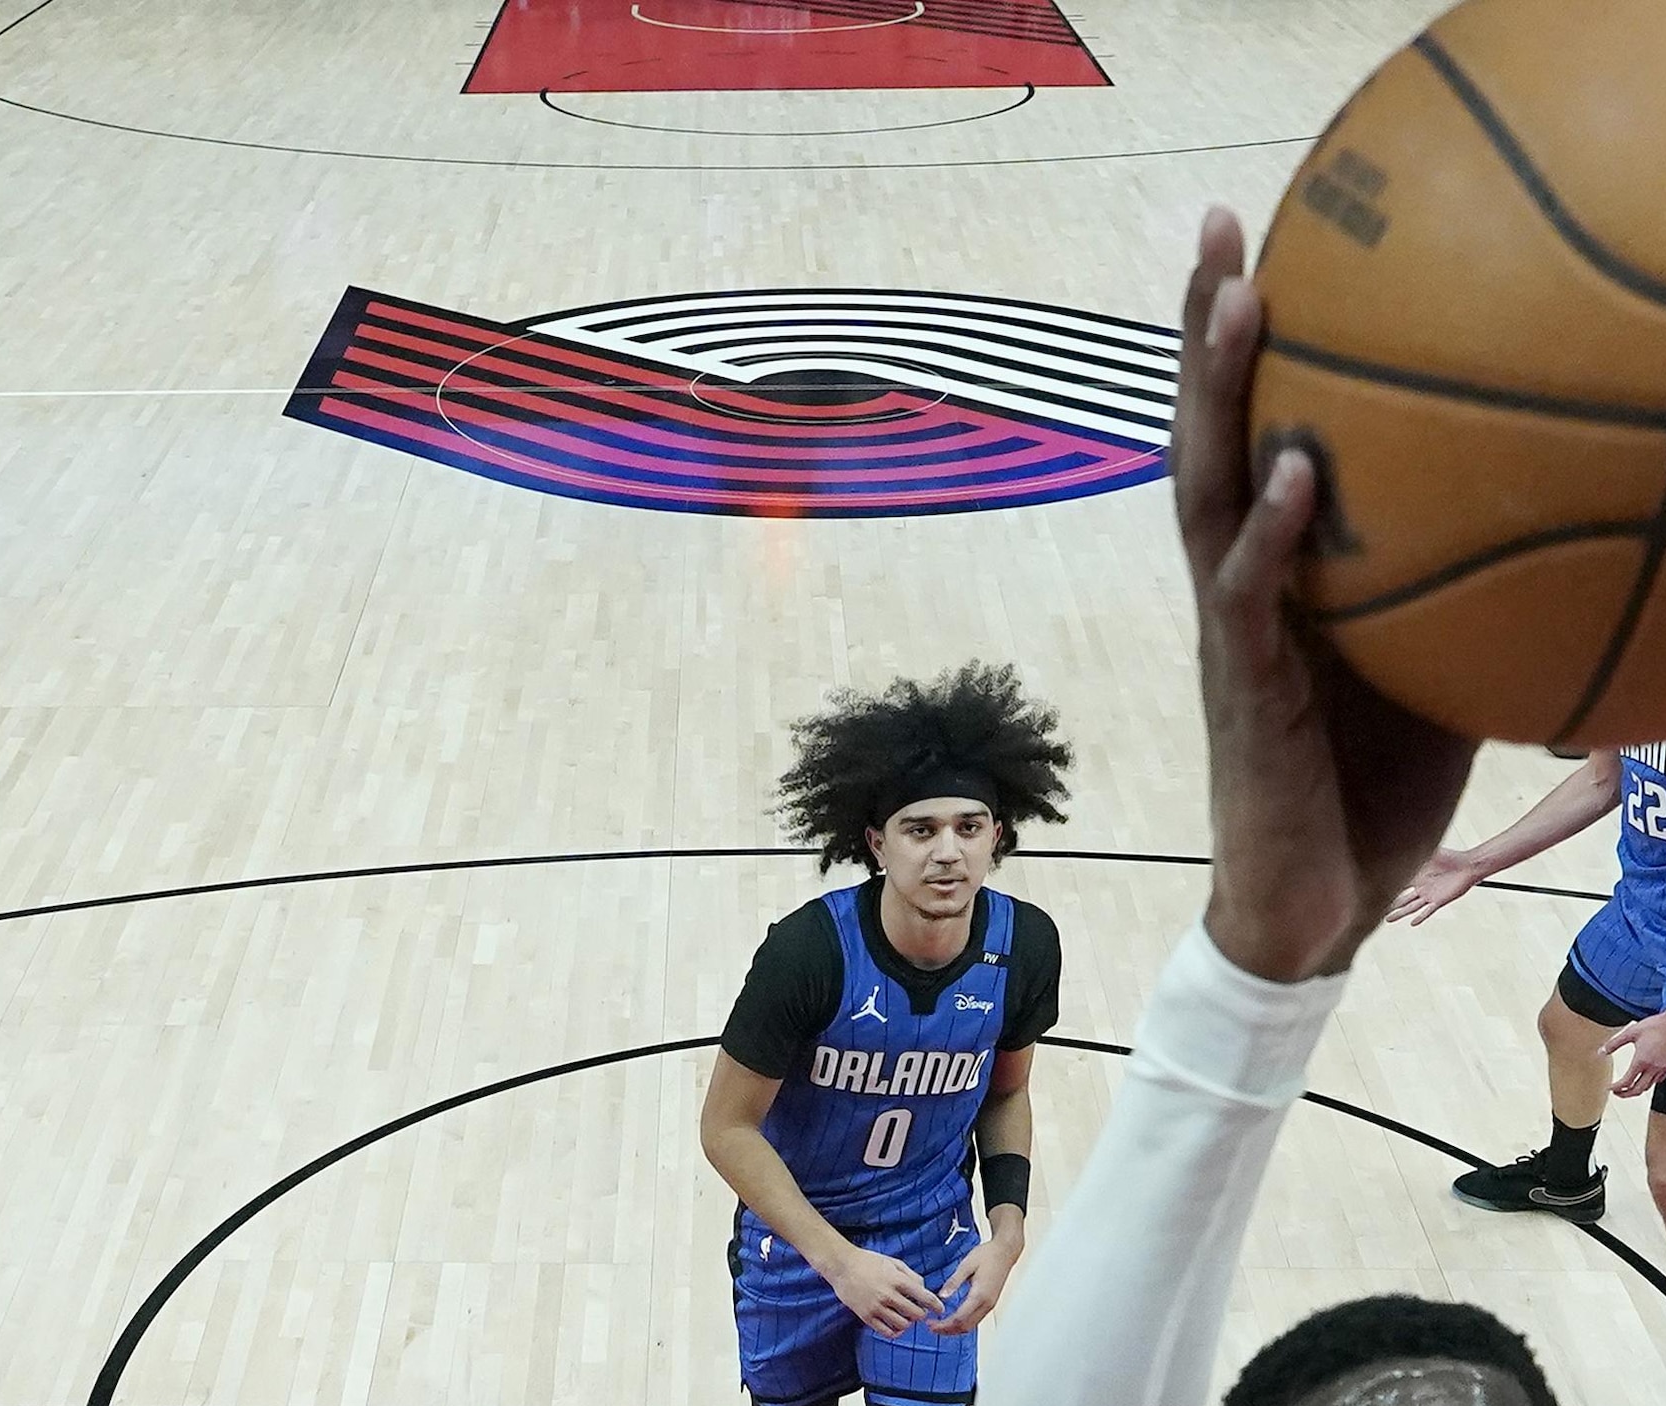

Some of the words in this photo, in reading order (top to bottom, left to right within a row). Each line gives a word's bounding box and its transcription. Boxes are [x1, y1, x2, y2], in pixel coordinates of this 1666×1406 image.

[983, 952, 999, 964] PW
[954, 993, 995, 1015] Disney
[810, 1045, 989, 1097] ORLANDO
[863, 1108, 913, 1168] 0
